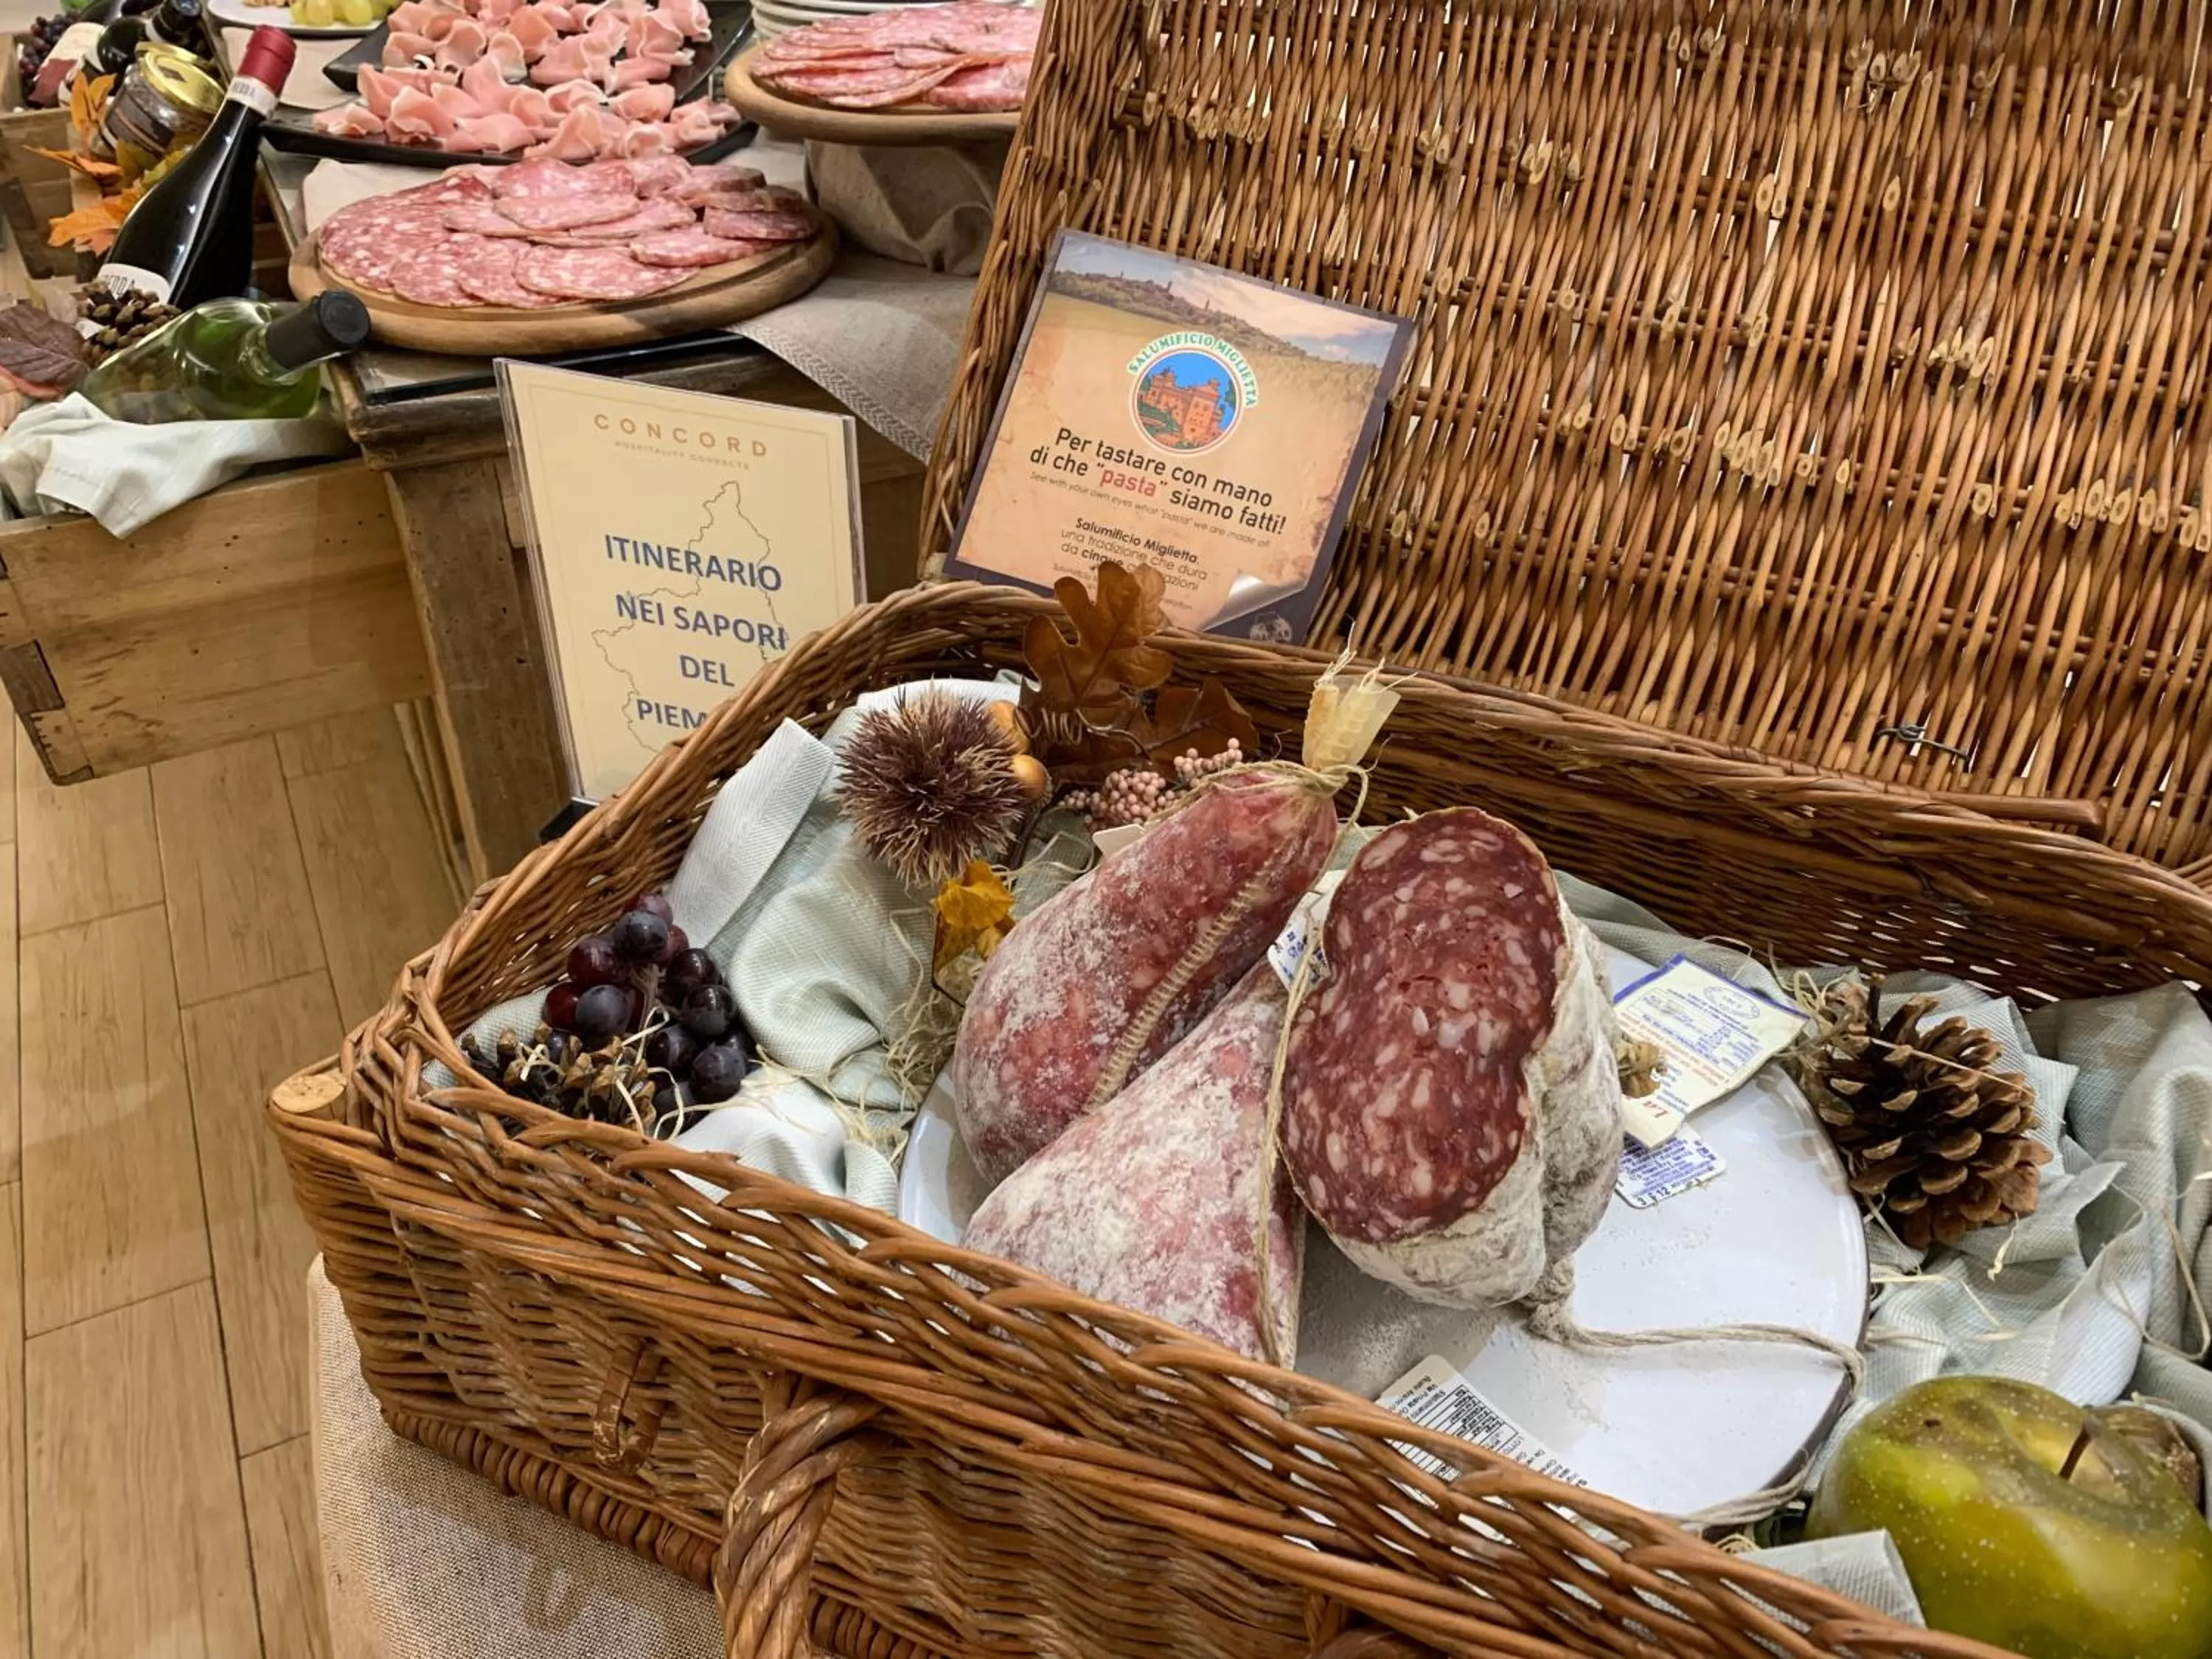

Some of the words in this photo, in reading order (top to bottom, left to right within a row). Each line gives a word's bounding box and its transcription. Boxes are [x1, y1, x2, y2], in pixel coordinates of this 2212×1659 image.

[1129, 333, 1213, 374] SALUMIFICIO
[1217, 340, 1258, 406] MIGLIETTA
[594, 414, 768, 456] CONCORD
[1030, 446, 1047, 466] di
[1053, 452, 1088, 476] che
[1169, 488, 1234, 520] siamo
[1239, 506, 1287, 535] fatti!
[1054, 428, 1092, 451] Per
[1096, 440, 1166, 475] tastare
[1171, 465, 1207, 488] con
[1212, 479, 1273, 507] mano
[1061, 542, 1078, 555] da
[1061, 528, 1085, 544] una
[1150, 553, 1175, 570] che
[1178, 562, 1208, 581] dura
[1075, 517, 1141, 546] Salumificio
[605, 534, 782, 591] ITINERARIO
[616, 594, 664, 626] NEI
[673, 606, 786, 650] SAPORI
[679, 655, 735, 687] DEL
[636, 698, 709, 729] PIEM
